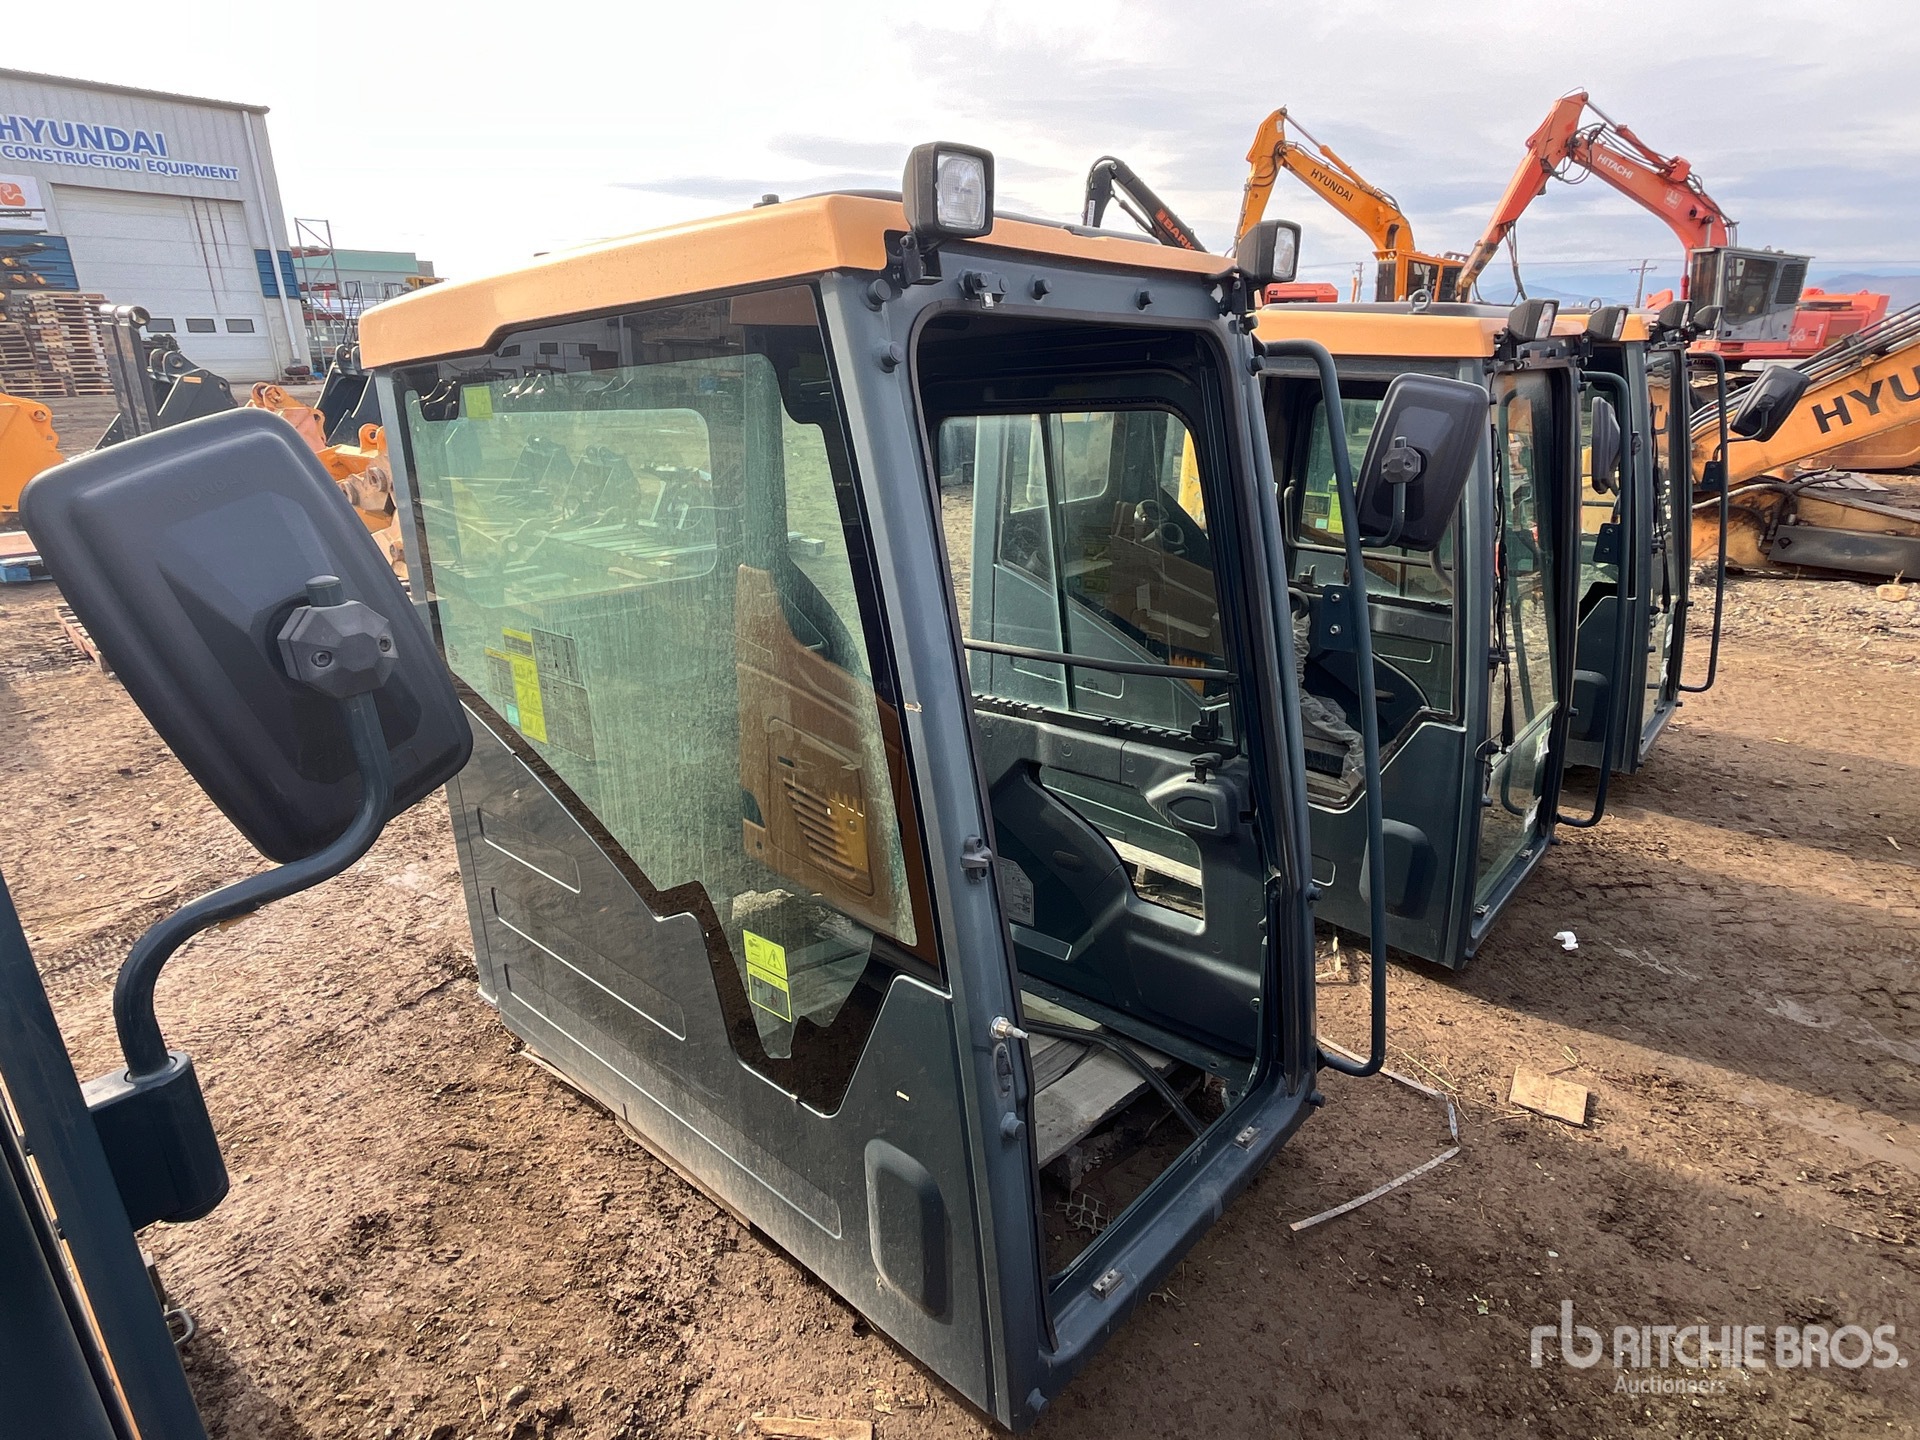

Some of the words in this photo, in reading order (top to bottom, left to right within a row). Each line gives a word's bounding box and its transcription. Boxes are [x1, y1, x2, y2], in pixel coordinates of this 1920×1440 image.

[0, 115, 168, 157] HYUNDAI
[2, 144, 141, 171] CONSTRUCTION
[145, 159, 239, 180] EQUIPMENT
[1597, 153, 1634, 180] HITACHI
[1310, 168, 1354, 202] HYUNDAI
